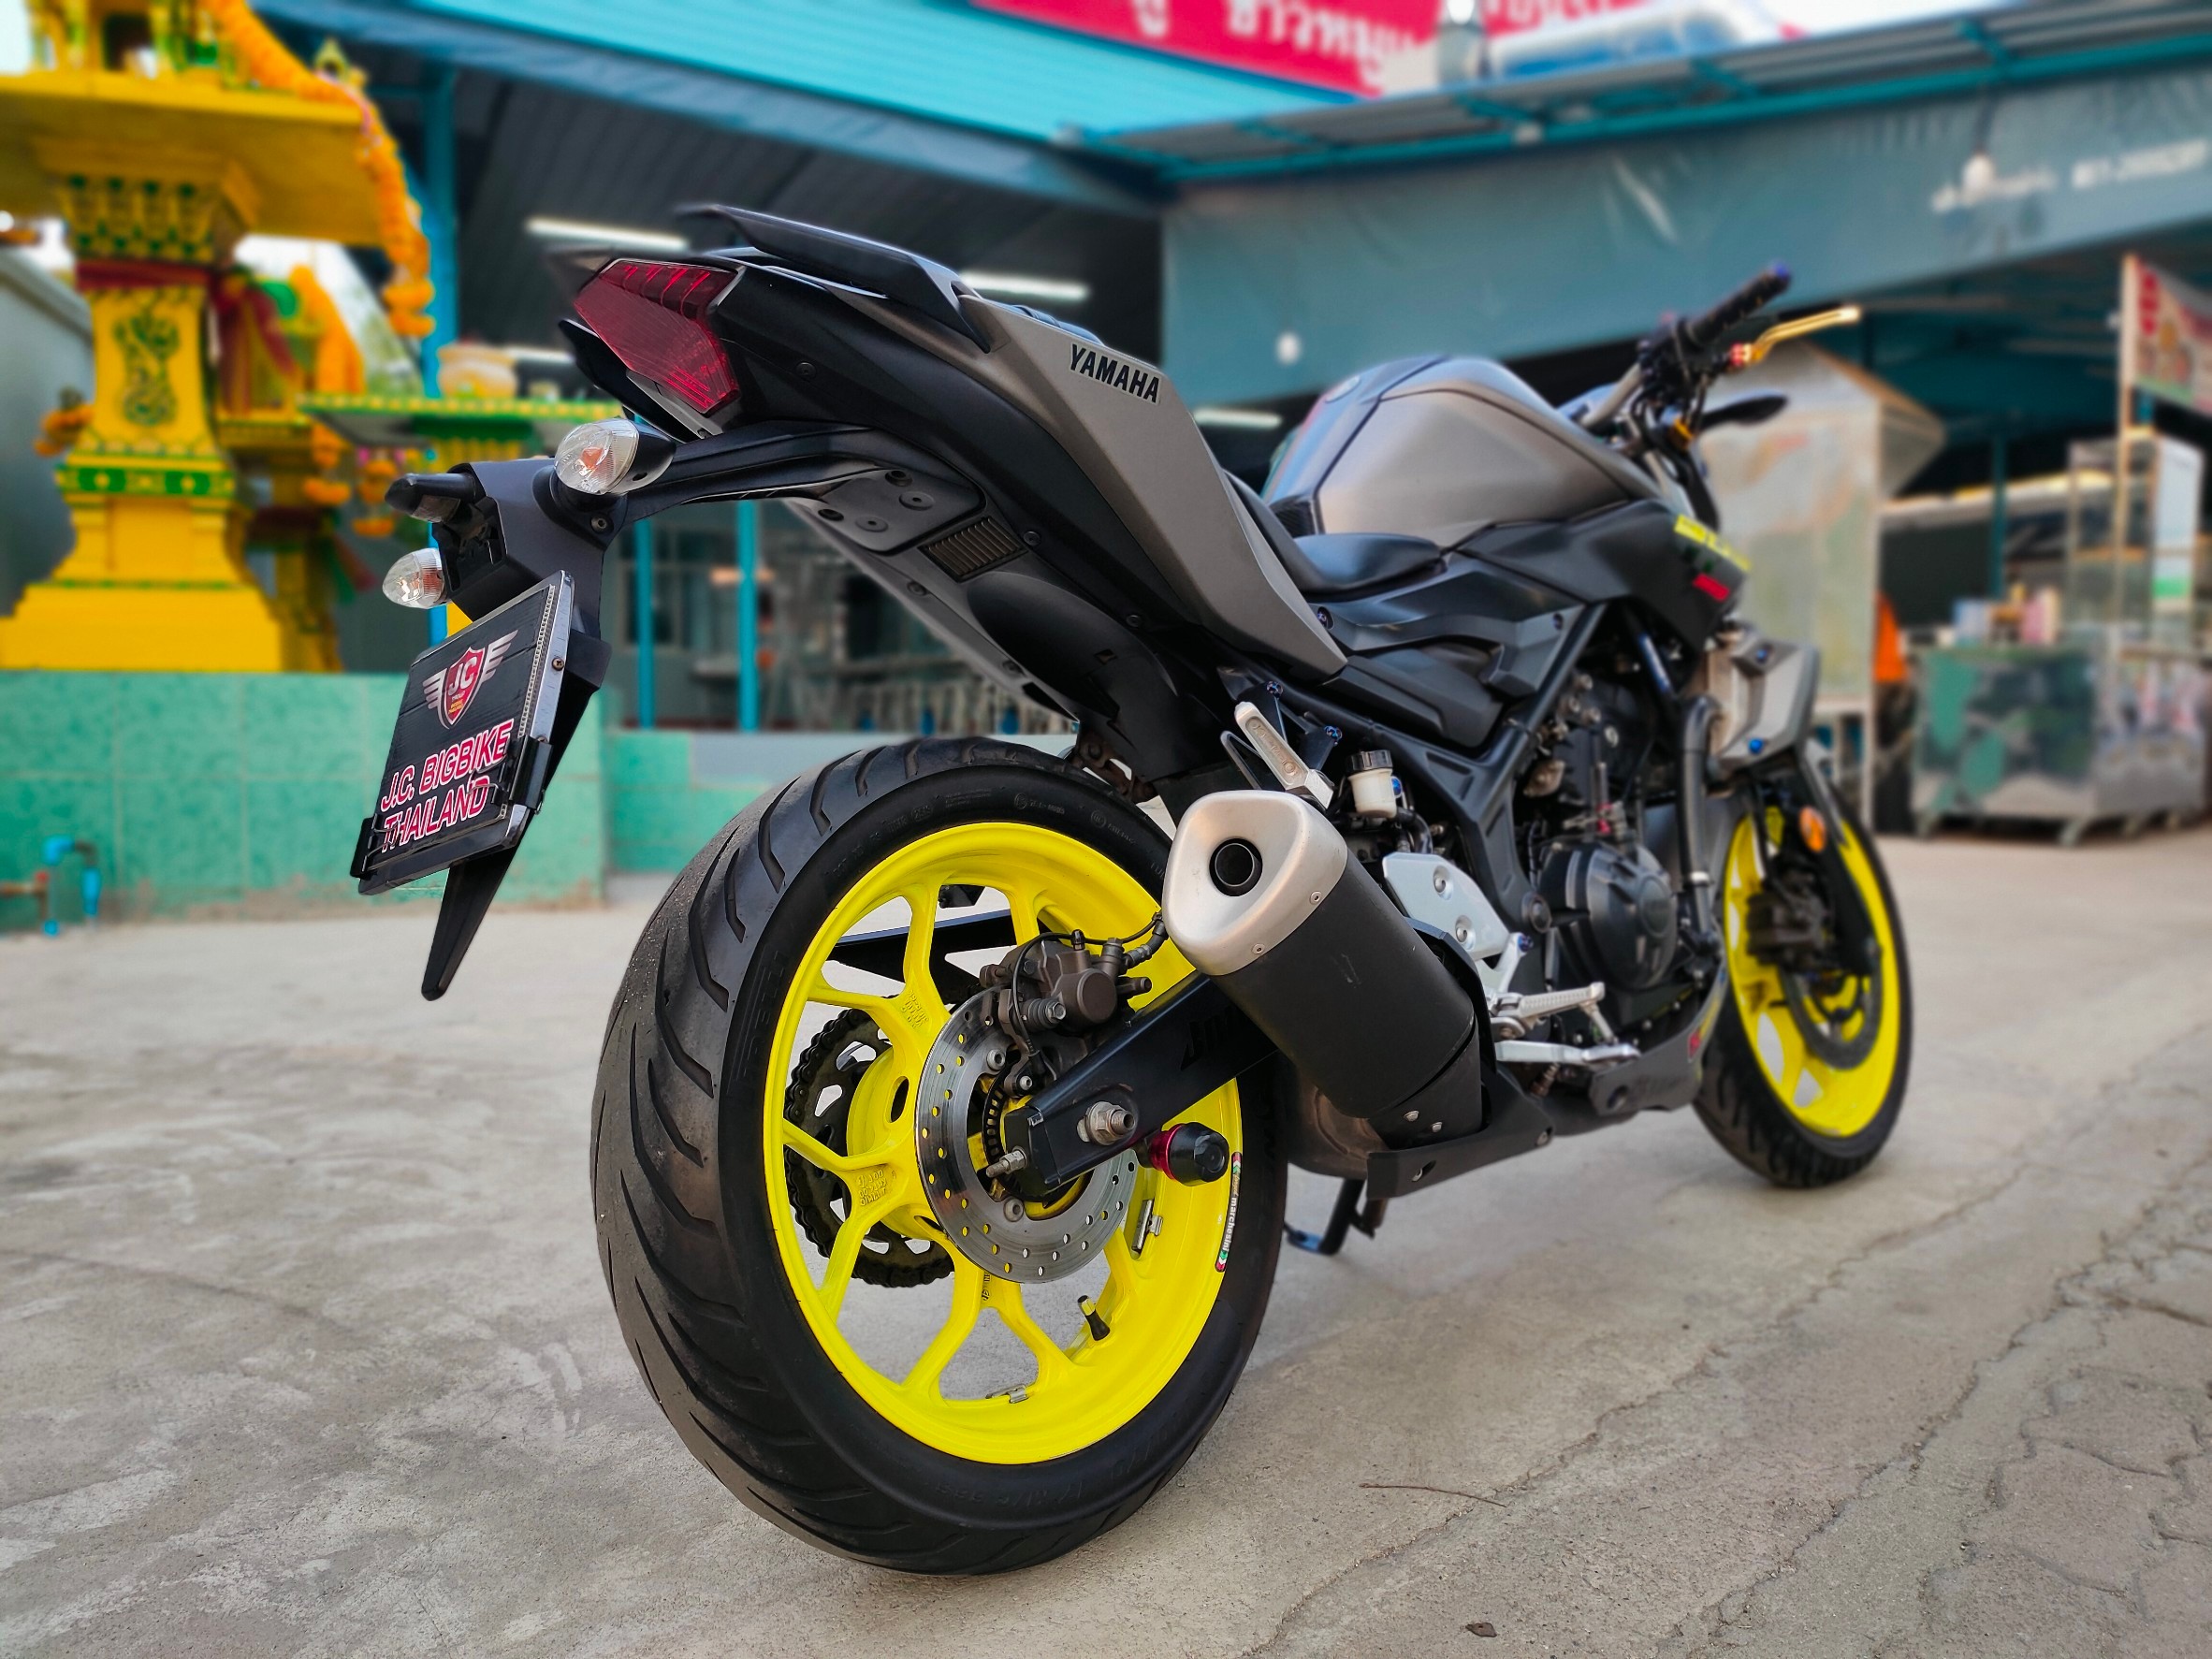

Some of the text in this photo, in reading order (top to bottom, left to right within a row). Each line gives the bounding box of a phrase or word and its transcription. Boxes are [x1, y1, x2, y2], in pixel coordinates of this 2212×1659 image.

[1070, 342, 1160, 404] YAMAHA
[447, 656, 478, 696] JC
[380, 718, 515, 812] J.C. BIGBIKE
[381, 775, 490, 853] THAILAND
[1222, 1198, 1238, 1252] marchesini
